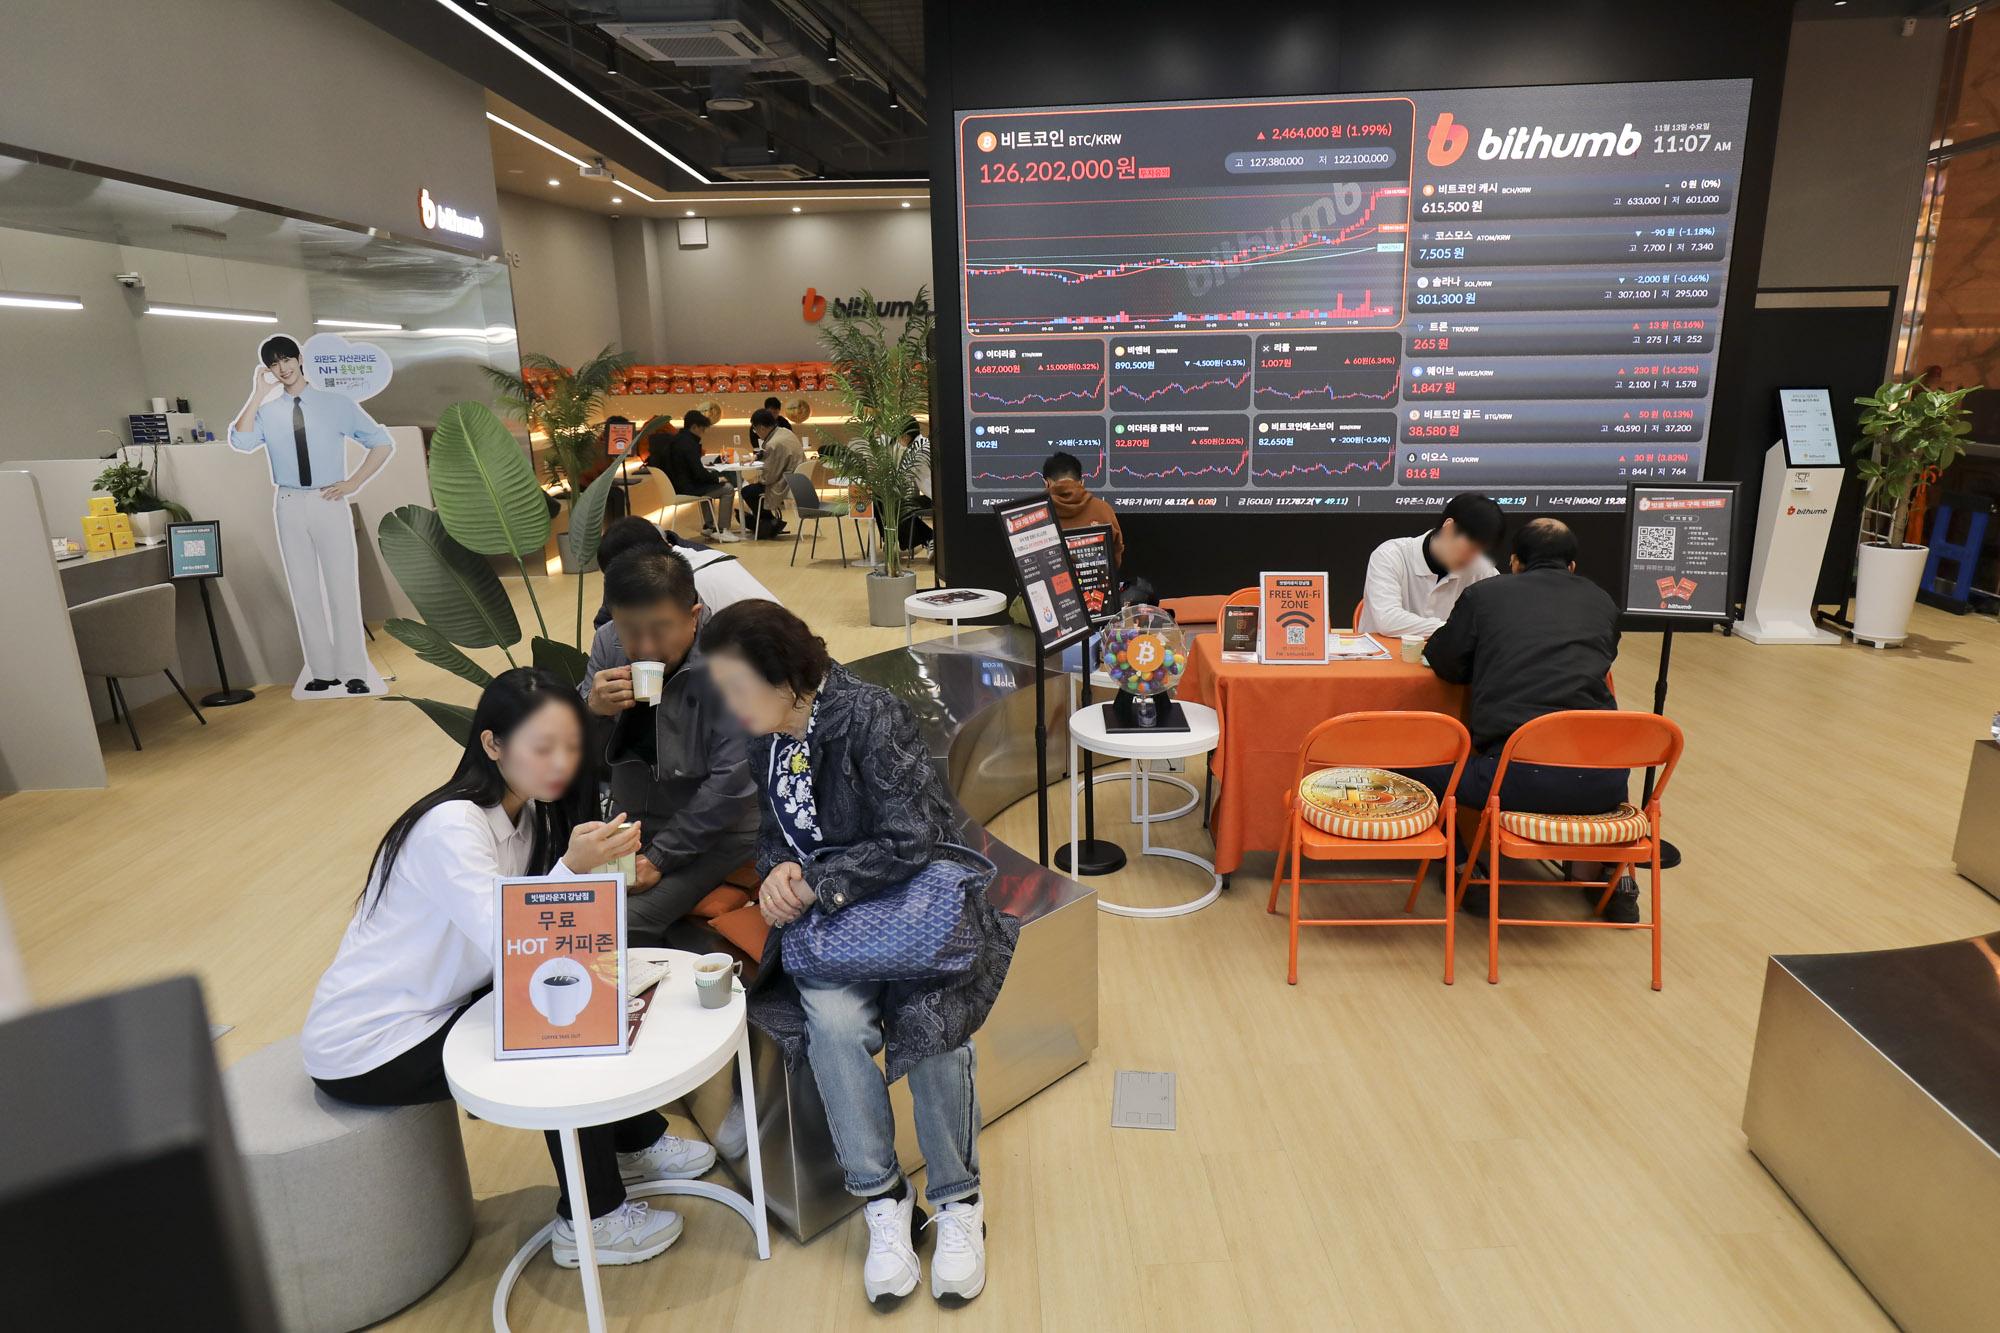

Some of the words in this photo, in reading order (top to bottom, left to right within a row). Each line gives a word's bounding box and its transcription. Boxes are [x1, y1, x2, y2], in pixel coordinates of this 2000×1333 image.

[1272, 127, 1329, 140] 2,464,000
[1331, 125, 1342, 138] 원
[1346, 123, 1392, 138] (1.99%)
[1654, 124, 1670, 132] 11월
[1672, 123, 1687, 131] 13일
[1689, 122, 1710, 130] 수요일
[1001, 130, 1064, 149] 비트코인
[1068, 134, 1122, 147] BTC/KRW
[1477, 123, 1642, 161] bithumb
[1654, 134, 1711, 153] 11:07
[1714, 142, 1731, 151] AM
[1235, 158, 1243, 167] 고
[1250, 157, 1304, 167] 127,380,000
[1319, 156, 1327, 165] 저
[1334, 154, 1388, 164] 122,100,000
[1438, 184, 1476, 195] 비트코인
[1478, 183, 1498, 193] 캐시
[1701, 179, 1721, 189] (0%)
[1627, 197, 1660, 206] 633,000
[1672, 196, 1680, 204] 저
[1686, 195, 1719, 204] 601,000
[1422, 202, 1469, 214] 615,500
[1472, 200, 1483, 212] 원
[1435, 231, 1473, 240] 코스모스
[1667, 228, 1675, 236] 원
[1680, 227, 1715, 237] (-1.18%)
[1643, 244, 1666, 252] 7,700
[1677, 243, 1685, 252] 저
[1691, 243, 1713, 251] 7,340
[1420, 248, 1451, 260] 7,505
[1454, 247, 1464, 259] 원
[1432, 276, 1461, 287] 솔라나
[1634, 275, 1660, 284] -2,000
[1662, 274, 1670, 283] 원
[1674, 274, 1709, 283] (-0.66%)
[1416, 294, 1462, 305] 301,300
[1465, 293, 1476, 304] 원
[1618, 290, 1650, 299] 307,100
[1662, 290, 1669, 298] 저
[1675, 290, 1708, 298] 295,000
[1429, 322, 1448, 332] 트론
[1662, 321, 1669, 329] 원
[1673, 320, 1704, 330] (5.16%)
[1414, 339, 1435, 350] 265
[1438, 338, 1449, 350] 원
[1673, 335, 1681, 344] 저
[1127, 346, 1150, 355] 비엔비
[1274, 344, 1290, 352] 리플
[339, 354, 376, 363] 자산관리도
[986, 350, 1016, 359] 이더리움
[1115, 361, 1155, 370] 890,500원
[1261, 359, 1292, 368] 1,007원
[319, 366, 338, 374] NH
[339, 364, 373, 375] 올원뱅크
[975, 364, 1020, 374] 4,687,000원
[1427, 366, 1454, 376] 웨이브
[1651, 366, 1659, 374] 원
[1663, 365, 1699, 374] (14.22%)
[1412, 383, 1443, 394] 1,847
[1445, 382, 1456, 393] 원
[1662, 380, 1669, 388] 저
[1424, 410, 1460, 419] 비트코인
[1463, 410, 1481, 419] 골드
[1651, 410, 1659, 419] 원
[1663, 409, 1694, 419] (0.13%)
[987, 426, 1010, 434] 에이다
[1127, 424, 1158, 432] 이더리움
[1160, 424, 1182, 432] 클래식
[1272, 422, 1334, 431] 비트코인에스브이
[1408, 426, 1447, 437] 38,580
[1449, 425, 1460, 437] 원
[1614, 425, 1640, 433] 40,590
[1652, 424, 1659, 433] 저
[976, 440, 998, 449] 802원
[1115, 439, 1149, 448] 32,870원
[1258, 438, 1294, 446] 82,650원
[1421, 453, 1448, 462] 이오스
[1647, 454, 1654, 462] 원
[1658, 453, 1688, 462] (3.82%)
[1406, 468, 1427, 479] 816
[1430, 468, 1440, 479] 원
[1658, 468, 1665, 476] 저
[1573, 497, 1602, 505] [NDAQ]
[1269, 590, 1292, 599] FREE
[1295, 590, 1320, 599] Wi-Fi
[531, 893, 567, 902] 빗썸라운지
[568, 892, 589, 901] 강남점
[538, 912, 576, 931] 무료
[506, 938, 548, 955] HOT
[555, 933, 614, 954] 커피존
